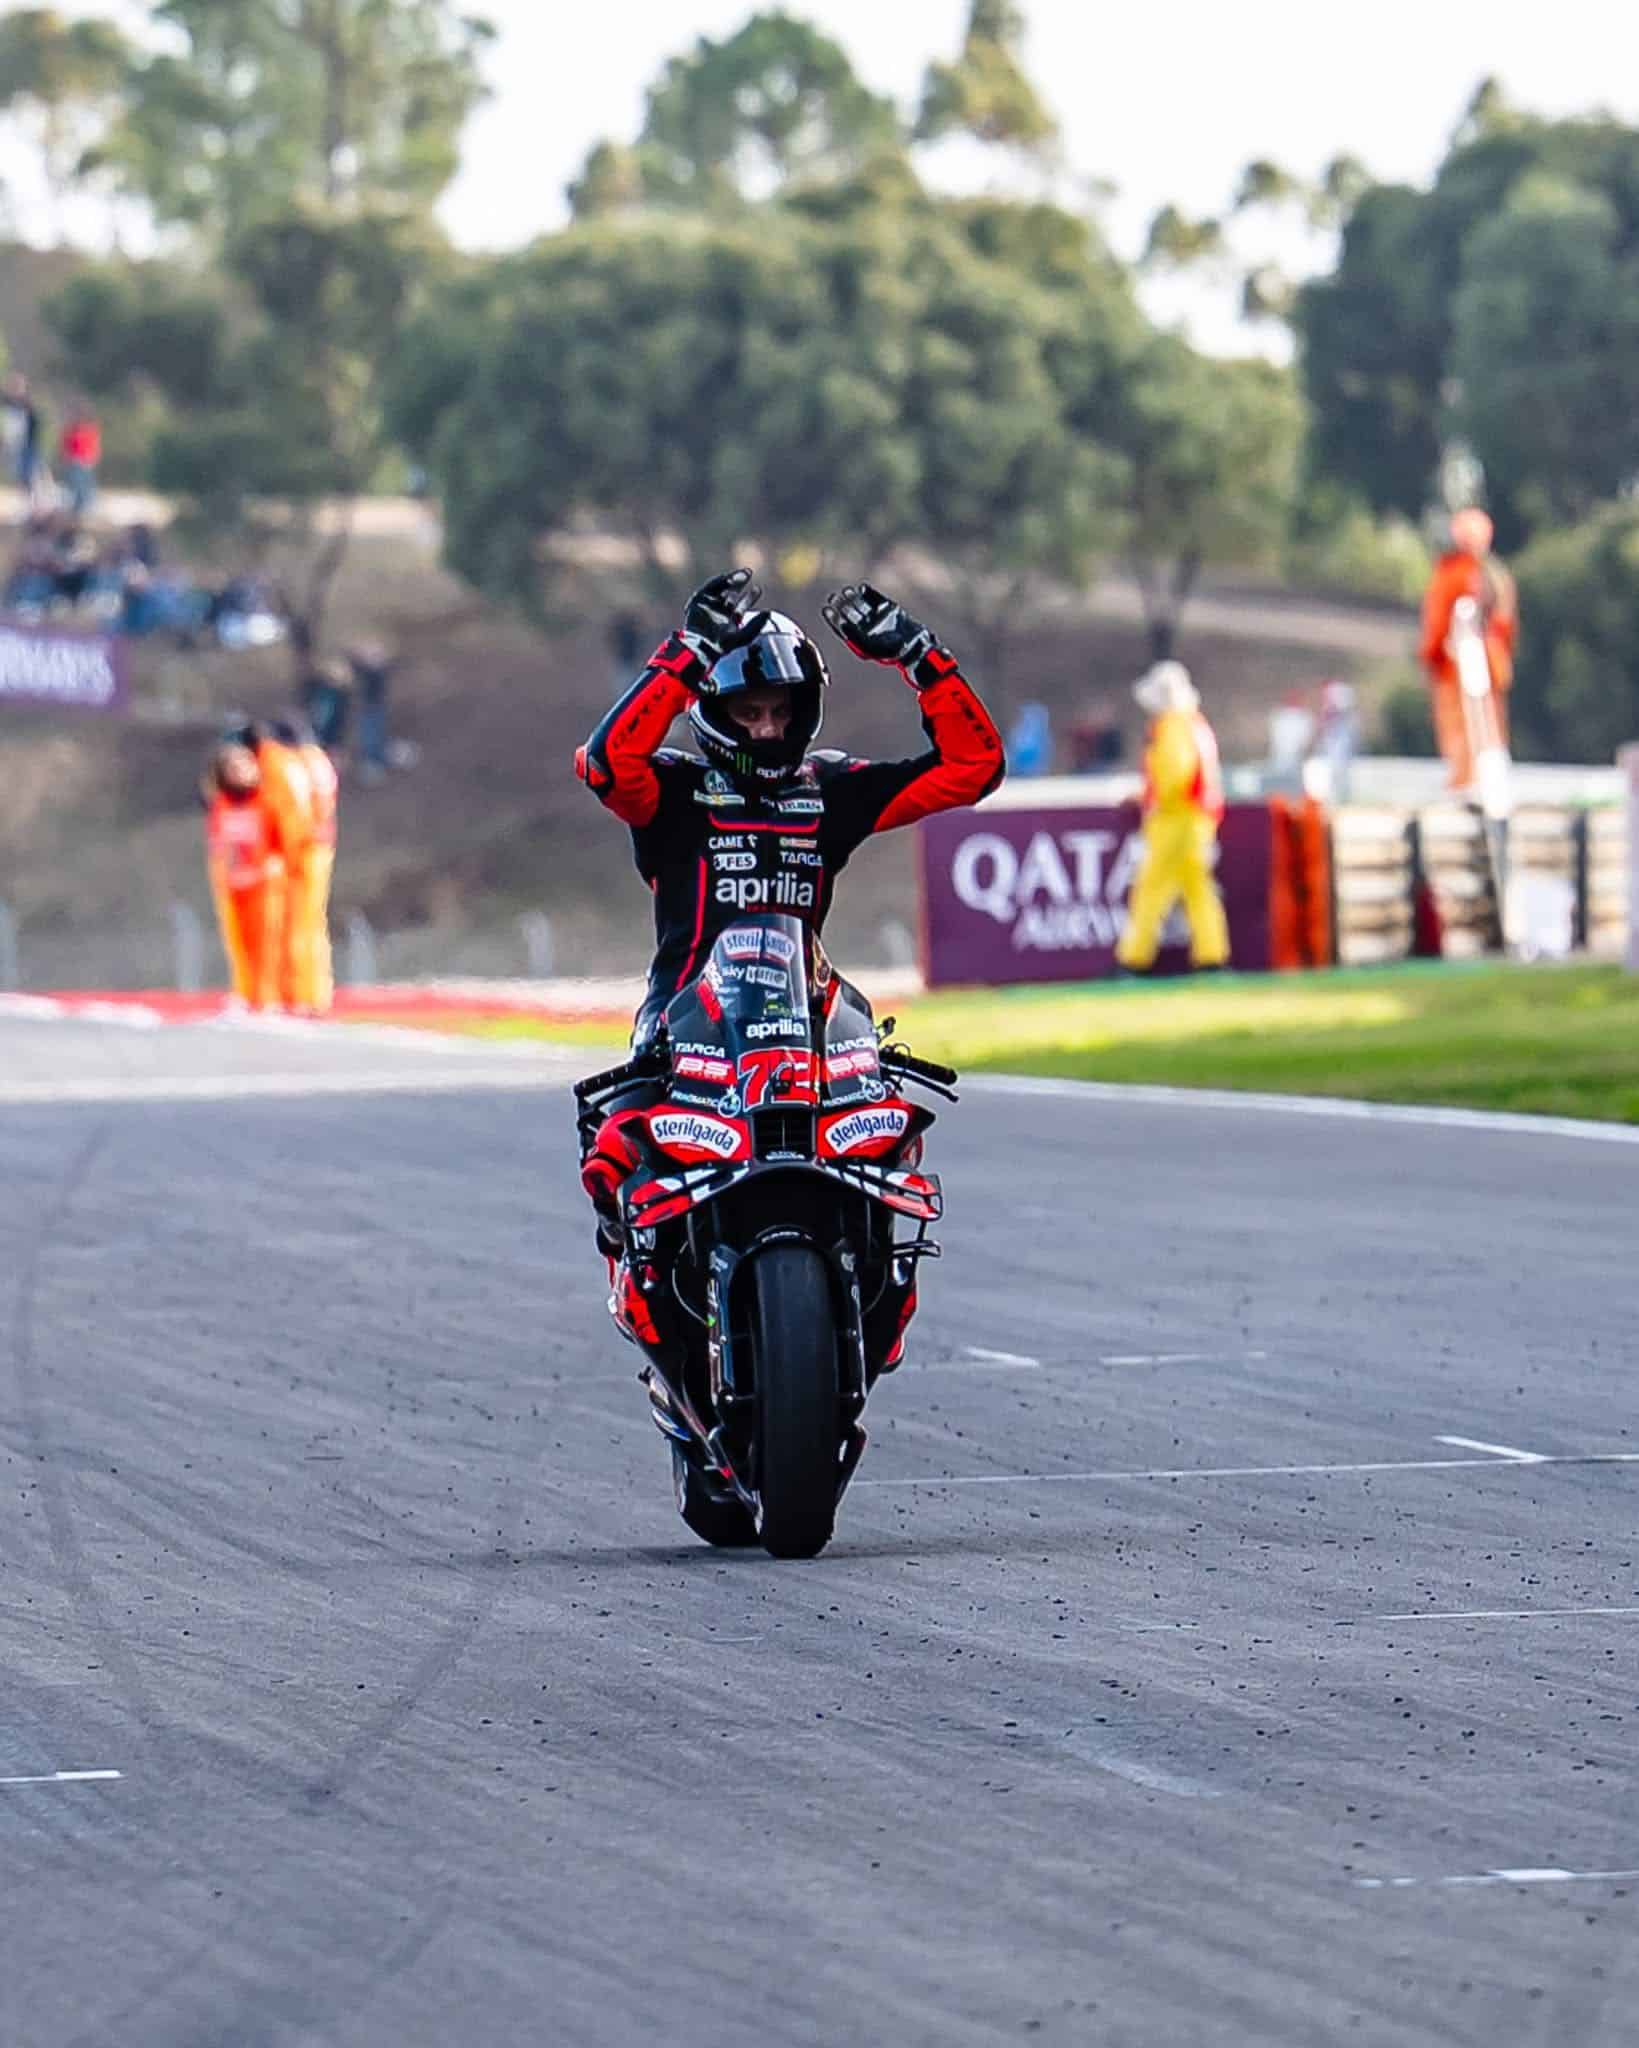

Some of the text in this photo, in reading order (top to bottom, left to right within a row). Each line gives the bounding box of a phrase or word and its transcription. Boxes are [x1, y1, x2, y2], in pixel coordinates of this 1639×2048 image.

[708, 836, 744, 849] CAME
[779, 852, 823, 867] TARGA
[715, 872, 814, 909] aprilia
[746, 1018, 806, 1039] aprilia
[675, 1043, 725, 1058] TARGA
[653, 1116, 734, 1151] sterilgarda
[831, 1111, 904, 1148] sterilgarda
